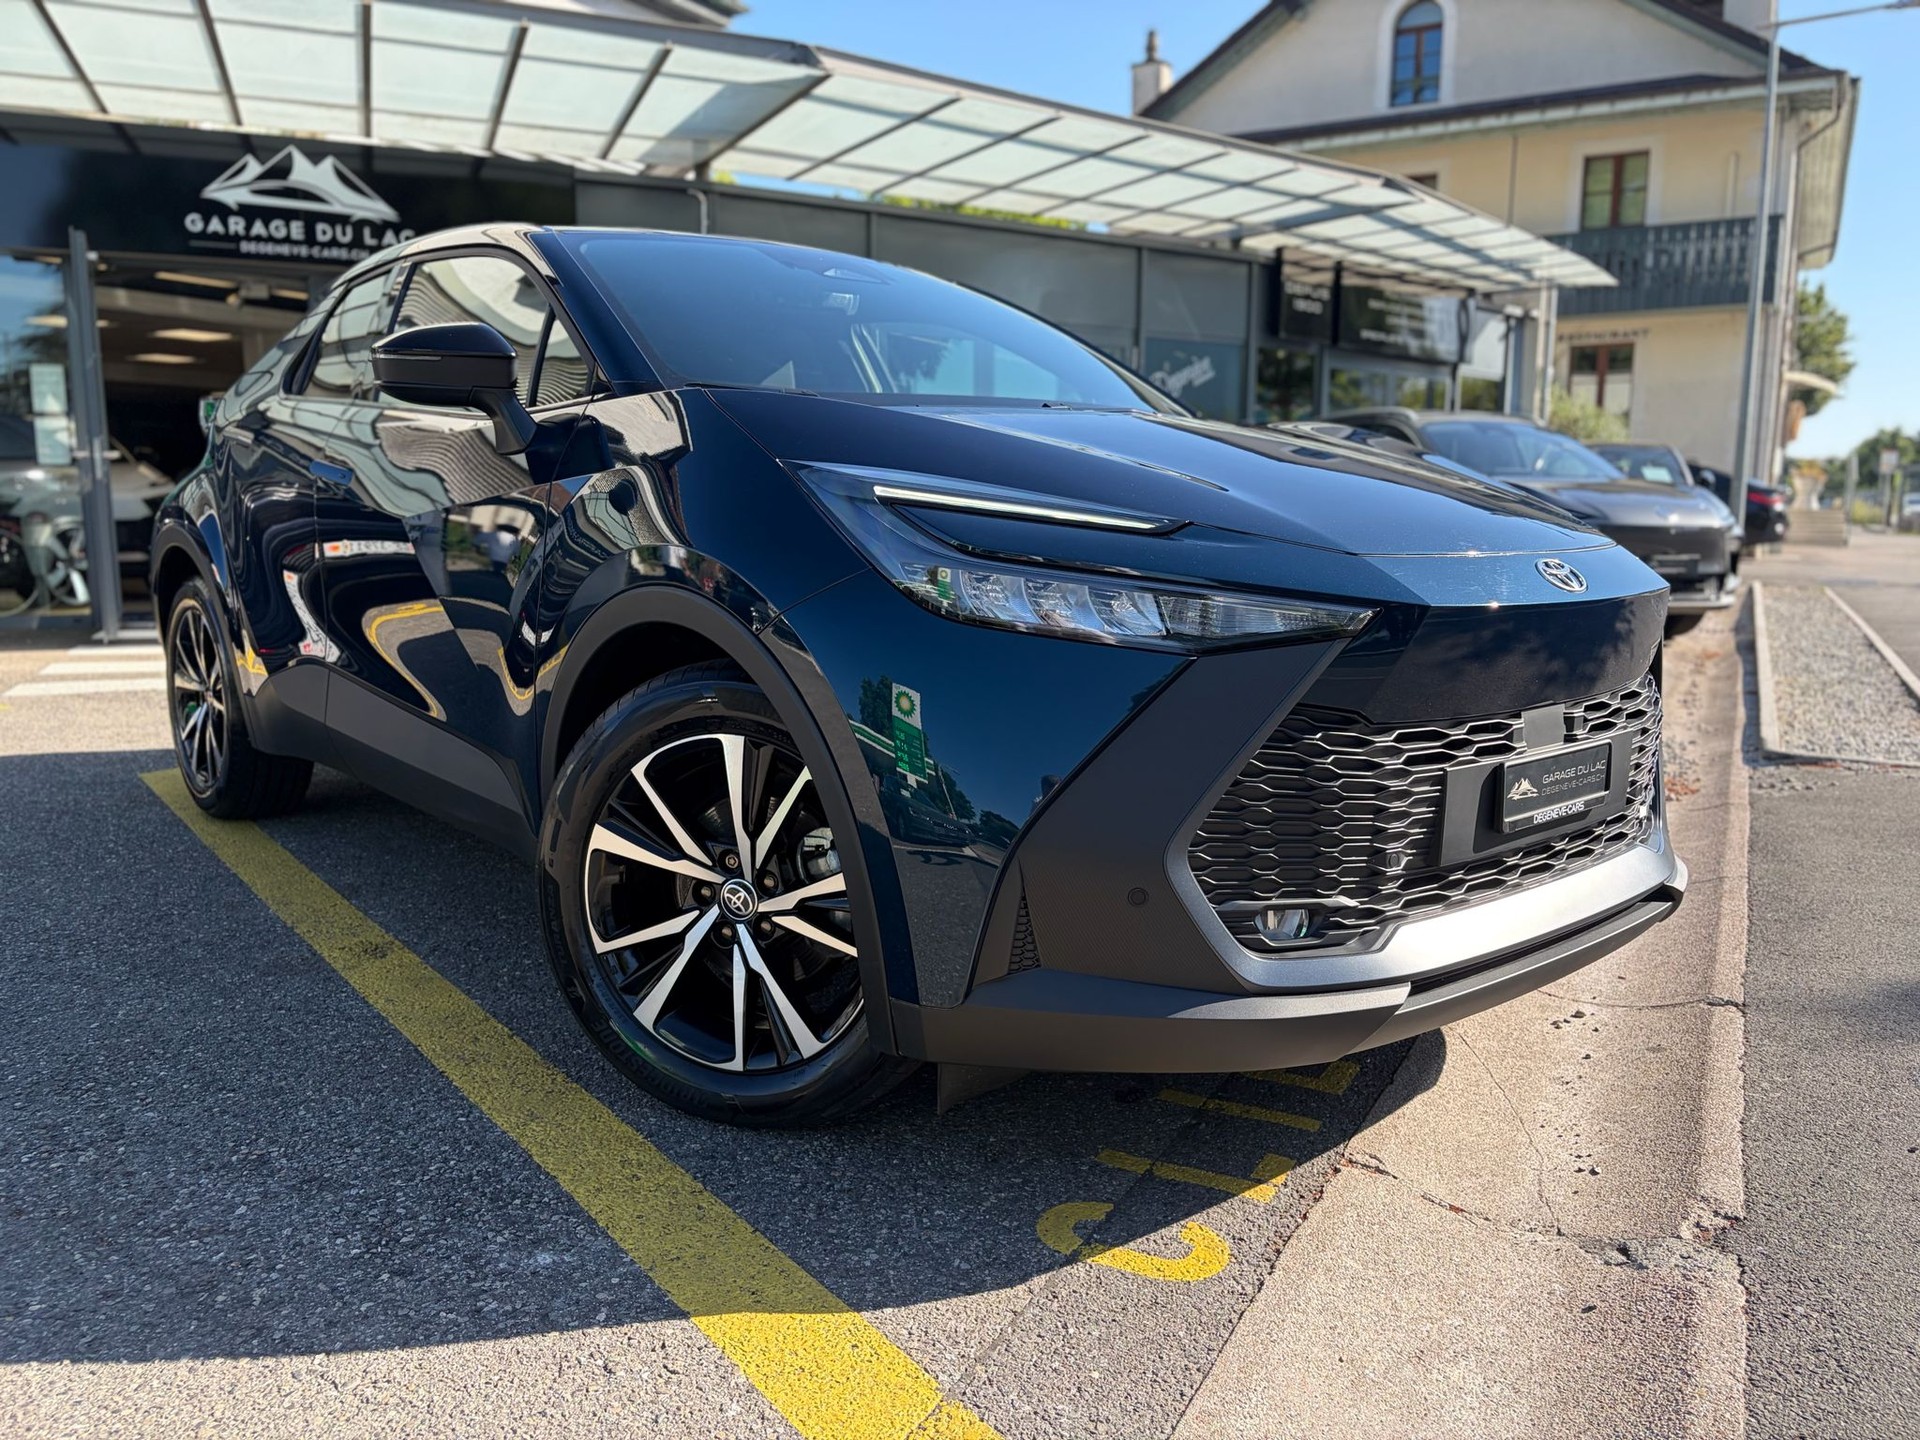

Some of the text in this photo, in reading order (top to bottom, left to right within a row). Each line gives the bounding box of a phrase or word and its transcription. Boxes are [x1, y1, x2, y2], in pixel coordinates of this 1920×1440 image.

[184, 212, 306, 241] GARAGE
[315, 222, 354, 245] DU
[1542, 760, 1606, 784] GARAGE DU LAC
[1533, 801, 1585, 824] DEGENEVE-CARS
